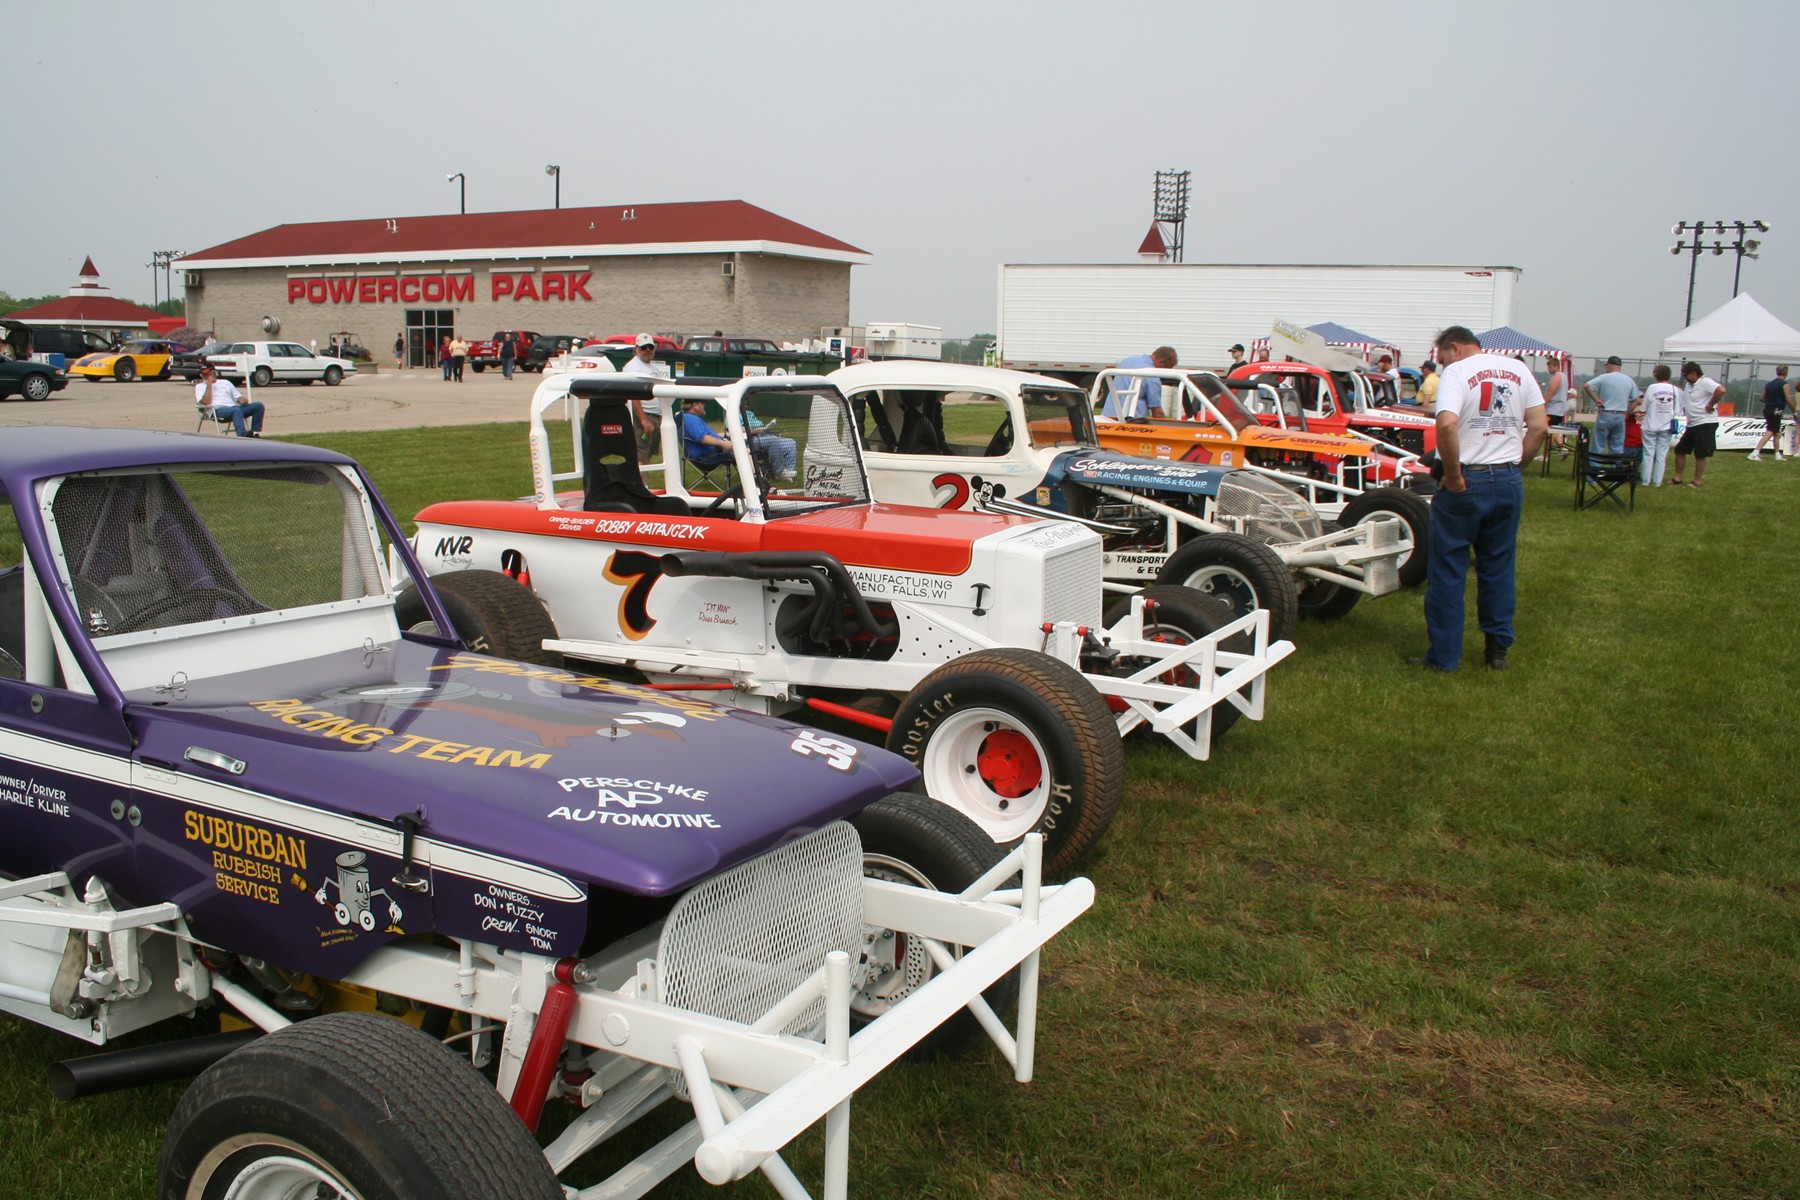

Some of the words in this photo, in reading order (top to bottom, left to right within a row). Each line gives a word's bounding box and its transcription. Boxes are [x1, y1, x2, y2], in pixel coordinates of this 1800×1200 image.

[287, 275, 476, 304] POWERCOM
[491, 272, 595, 301] PARK
[1096, 471, 1131, 481] RACING
[1132, 474, 1171, 485] ENGINES
[1158, 469, 1198, 478] SHOP
[819, 482, 841, 490] METAL
[929, 472, 970, 511] 2
[558, 523, 582, 532] DRIVER
[595, 519, 635, 534] BOBBY
[635, 521, 709, 540] RATAJCZYK
[434, 535, 474, 558] NVR
[850, 570, 953, 591] MANUFACTURING
[602, 548, 663, 640] 7
[248, 698, 395, 746] RACING
[388, 733, 554, 770] TEAM
[902, 691, 955, 766] oosier
[791, 730, 858, 770] 35
[557, 776, 709, 802] PERSCHKE
[598, 788, 664, 808] AP
[38, 798, 70, 818] KLINE
[547, 805, 722, 829] AUTOMOTIVE
[184, 810, 307, 870] SUBURBAN
[212, 850, 282, 884] RUBBISH
[216, 873, 280, 905] SERVICE
[474, 893, 497, 910] DON
[506, 902, 544, 923] FUZZY
[525, 922, 558, 940] SNORT
[530, 936, 552, 951] TOM
